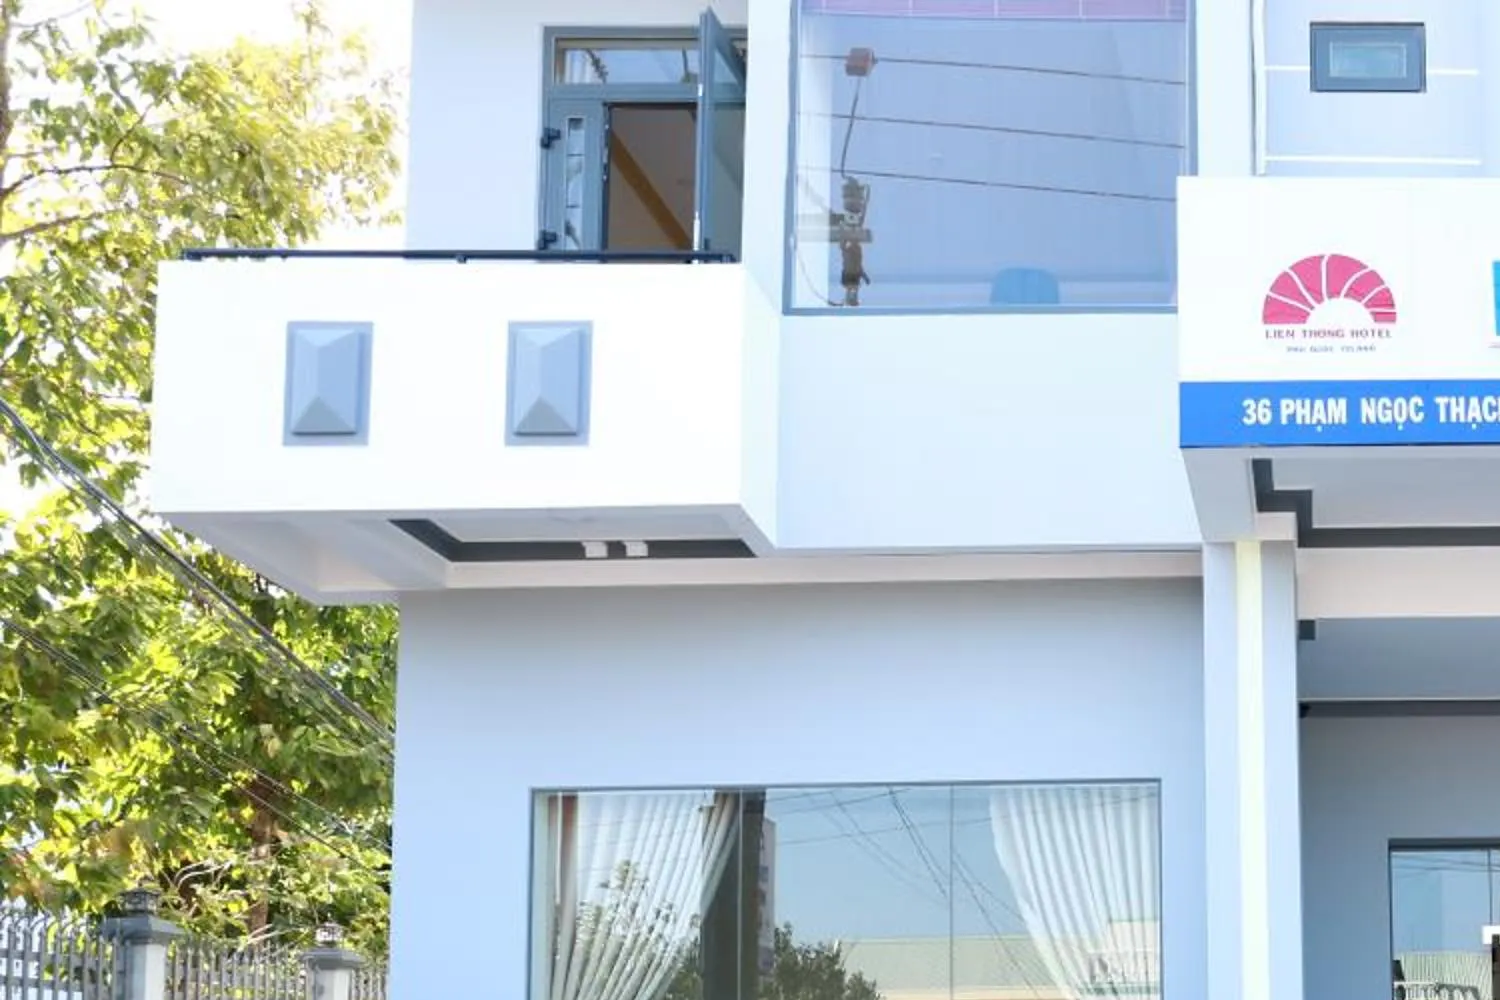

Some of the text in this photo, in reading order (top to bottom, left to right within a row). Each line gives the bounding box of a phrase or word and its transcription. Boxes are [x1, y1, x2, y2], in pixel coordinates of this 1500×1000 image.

[1242, 398, 1272, 425] 36
[1279, 397, 1347, 432] PHẠM
[1360, 395, 1425, 430] NGỌC
